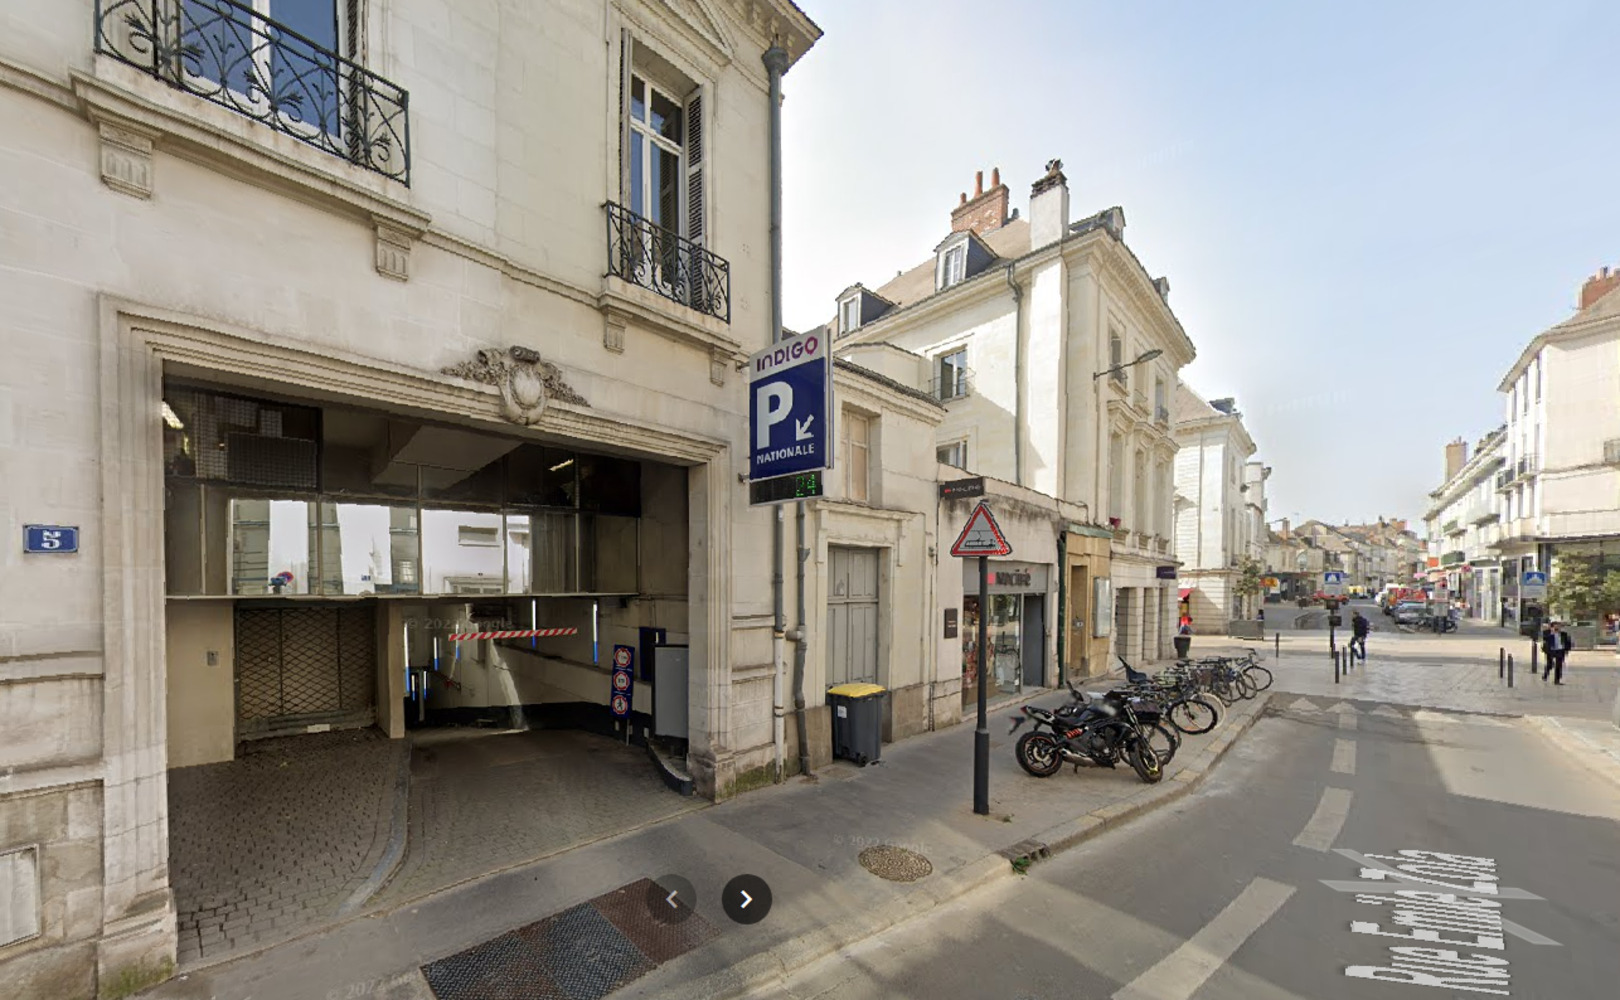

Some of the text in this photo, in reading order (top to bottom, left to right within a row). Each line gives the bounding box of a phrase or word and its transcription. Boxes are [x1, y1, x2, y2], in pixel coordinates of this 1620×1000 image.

[757, 336, 818, 372] INDIGO
[757, 381, 793, 450] P
[757, 443, 815, 465] NATIONALE
[41, 530, 61, 549] 5
